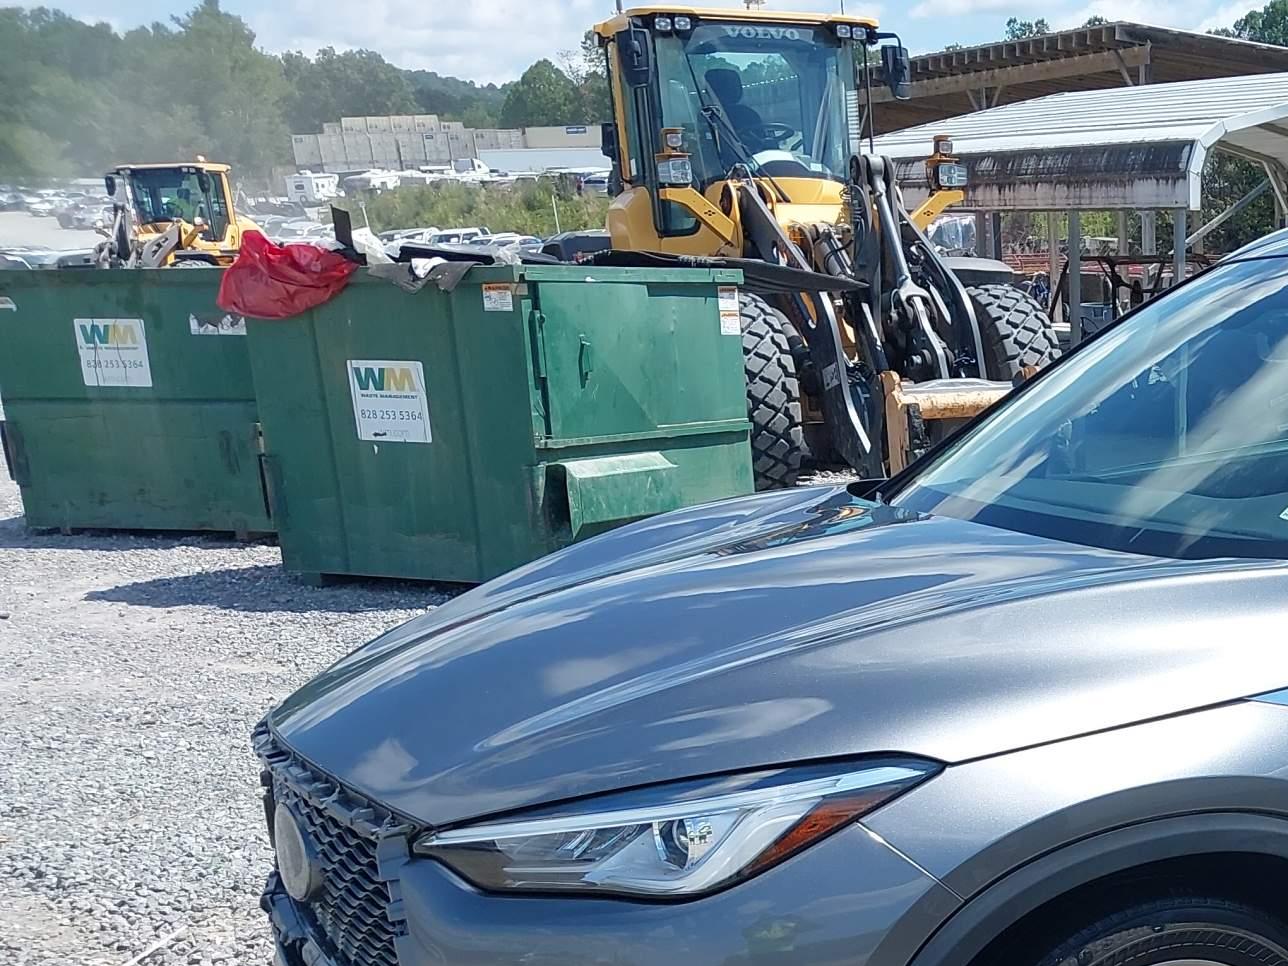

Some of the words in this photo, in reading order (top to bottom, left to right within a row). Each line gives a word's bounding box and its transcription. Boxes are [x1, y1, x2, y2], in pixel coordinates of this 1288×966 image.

[721, 25, 800, 40] VOLVO
[79, 324, 138, 345] WM
[104, 359, 120, 369] 253
[352, 366, 417, 392] WM
[360, 408, 378, 420] 828
[379, 409, 397, 421] 253
[399, 410, 423, 421] 5364
